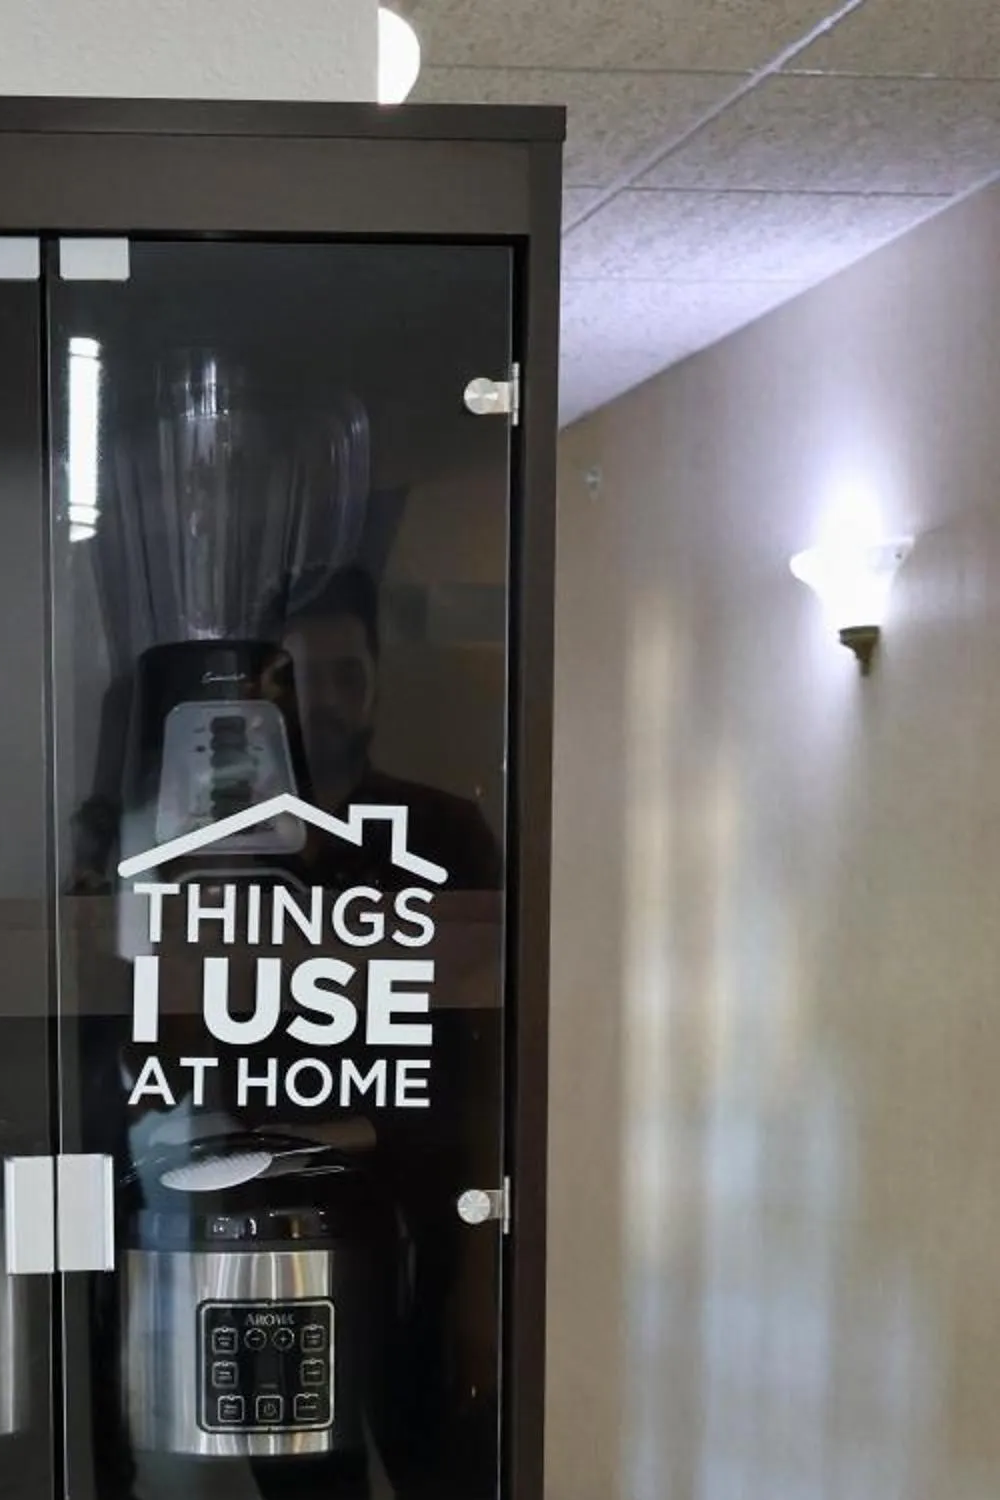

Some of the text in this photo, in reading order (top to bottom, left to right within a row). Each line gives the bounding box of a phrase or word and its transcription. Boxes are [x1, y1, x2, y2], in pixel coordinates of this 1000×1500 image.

[132, 882, 437, 947] THINGS
[133, 954, 436, 1045] I USE
[128, 1056, 432, 1108] AT HOME
